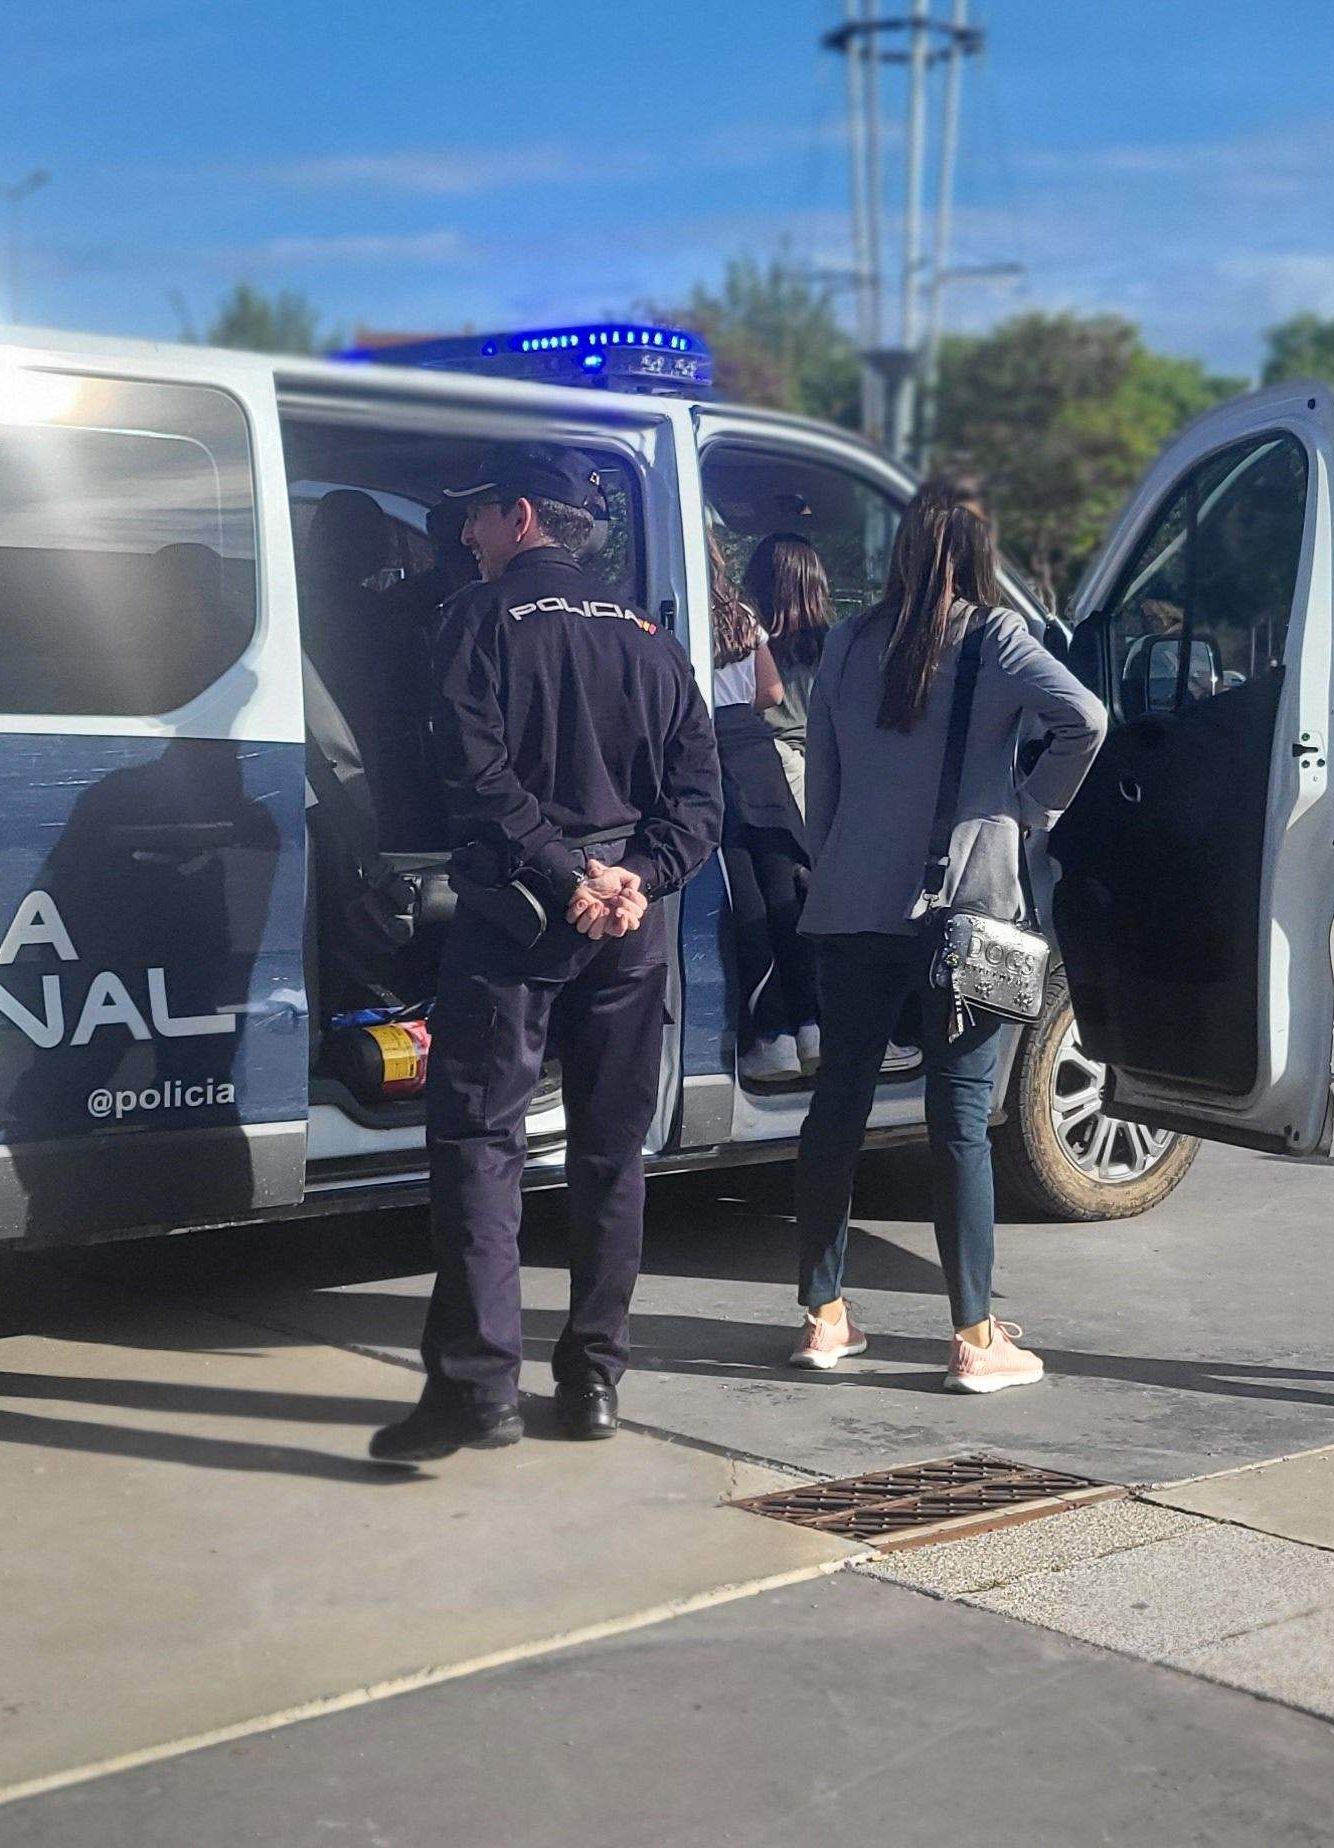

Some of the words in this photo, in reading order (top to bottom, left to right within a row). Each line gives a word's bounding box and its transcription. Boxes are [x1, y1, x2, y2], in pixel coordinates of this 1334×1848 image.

[508, 597, 644, 629] POLICIA
[969, 936, 1036, 976] DOGS
[87, 1078, 236, 1119] @policia
